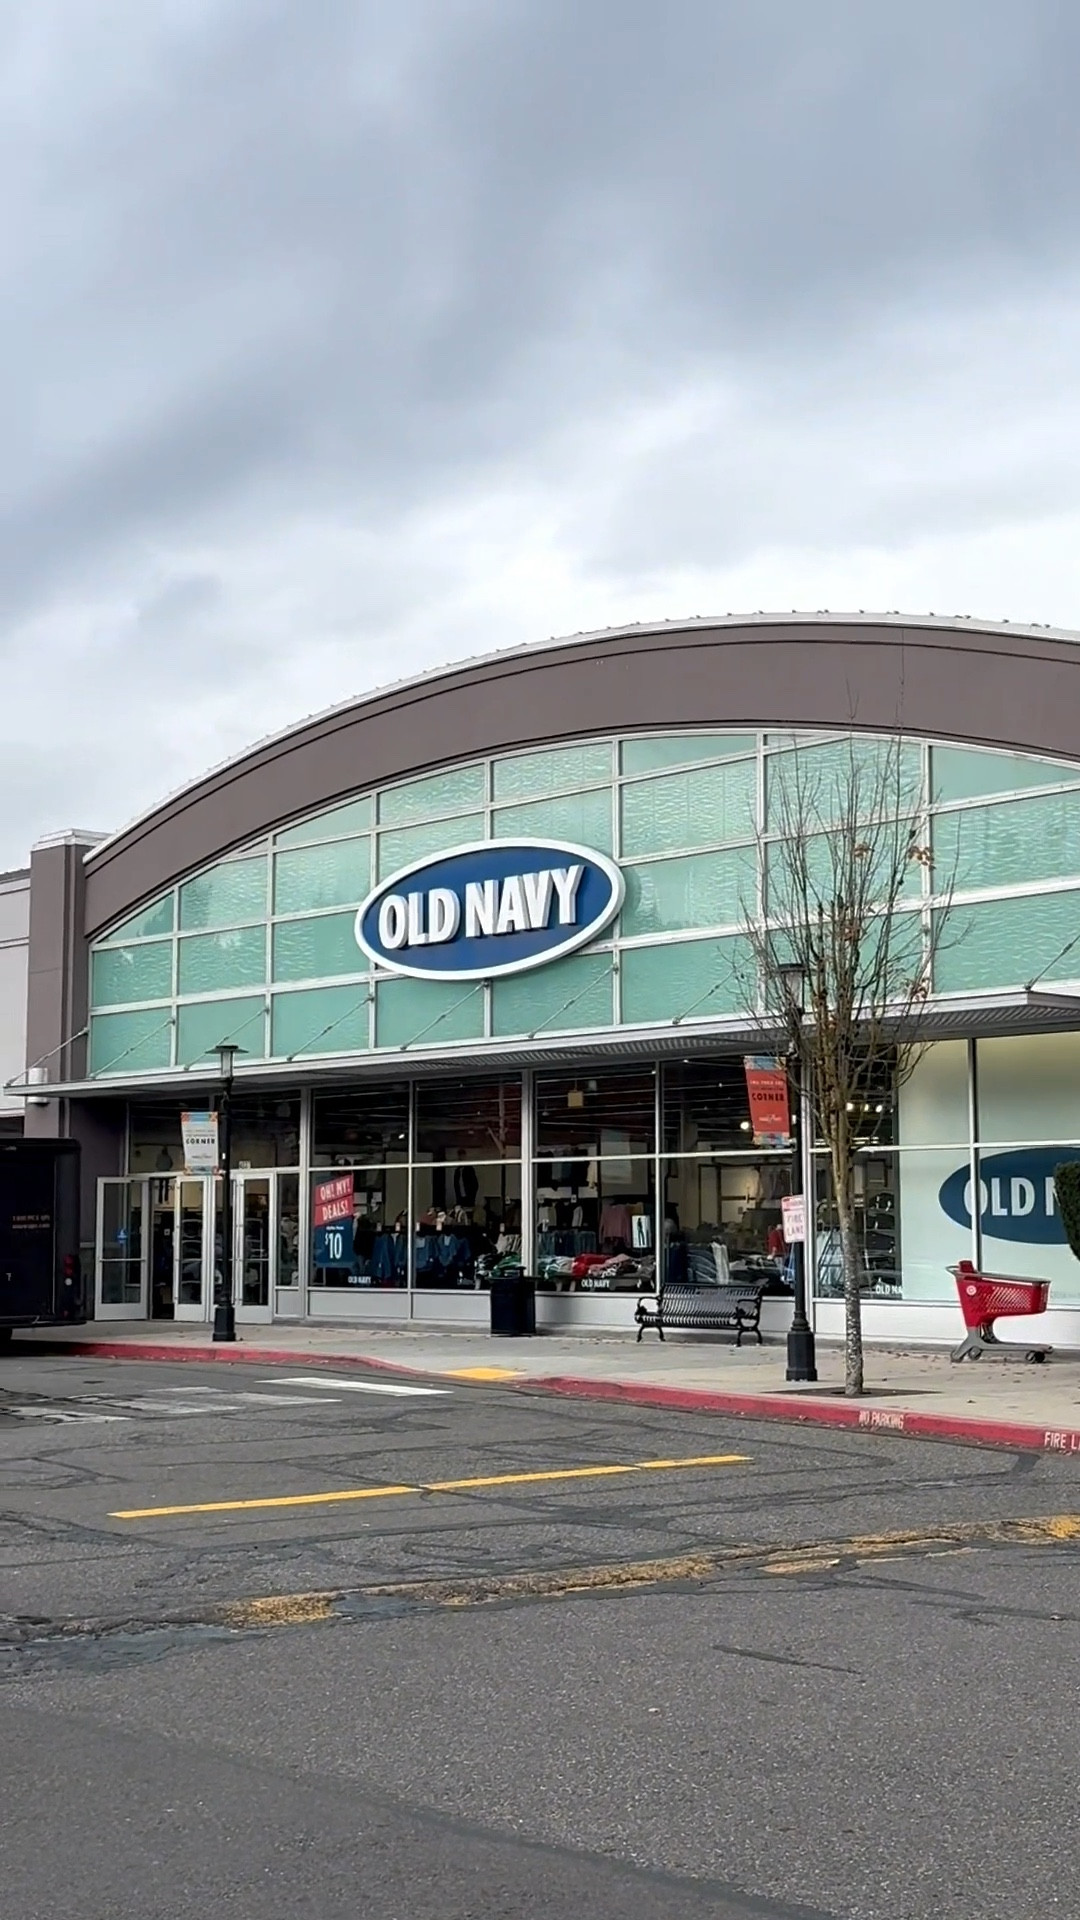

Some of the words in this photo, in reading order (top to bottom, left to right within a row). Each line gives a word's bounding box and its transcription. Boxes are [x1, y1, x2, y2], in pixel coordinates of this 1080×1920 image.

[378, 887, 461, 950] OLD
[465, 864, 586, 939] NAVY
[320, 1183, 335, 1201] OH!
[336, 1177, 351, 1197] MY!
[963, 1176, 1036, 1217] OLD
[322, 1199, 349, 1221] DEALS!
[325, 1232, 343, 1259] $10
[581, 1279, 593, 1288] OLD
[593, 1279, 610, 1288] NAVY
[875, 1285, 890, 1295] OLD
[859, 1410, 870, 1426] NO
[871, 1411, 905, 1430] PARKING
[1044, 1431, 1067, 1449] FIRE
[1071, 1433, 1080, 1450] L
